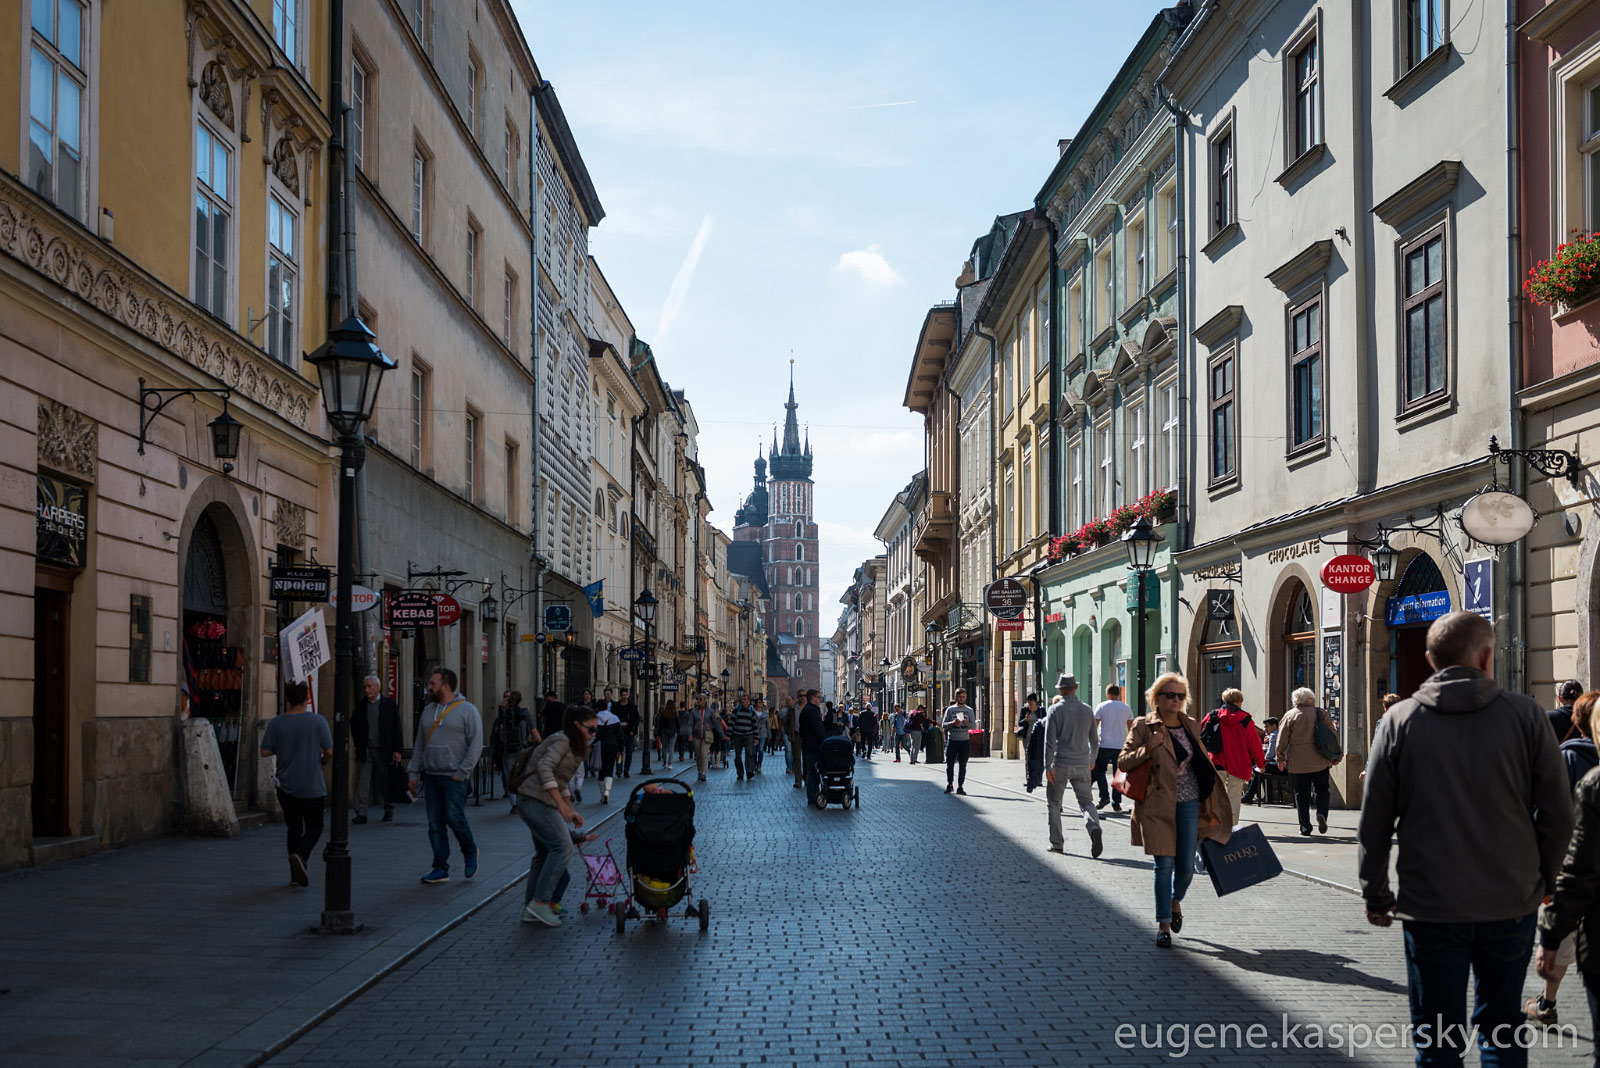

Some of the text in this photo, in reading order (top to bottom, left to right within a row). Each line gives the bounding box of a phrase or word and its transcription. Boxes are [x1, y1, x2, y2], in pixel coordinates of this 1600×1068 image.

[1267, 539, 1320, 565] CHOCOLATE
[1328, 564, 1371, 574] KANTOR
[1328, 576, 1371, 584] CHANGE
[331, 594, 374, 603] KTOR
[1002, 598, 1012, 606] 36
[1396, 596, 1446, 612] Tourist information
[393, 609, 435, 618] KEBAB
[298, 629, 318, 652] NIGHT
[301, 652, 322, 677] PARTY
